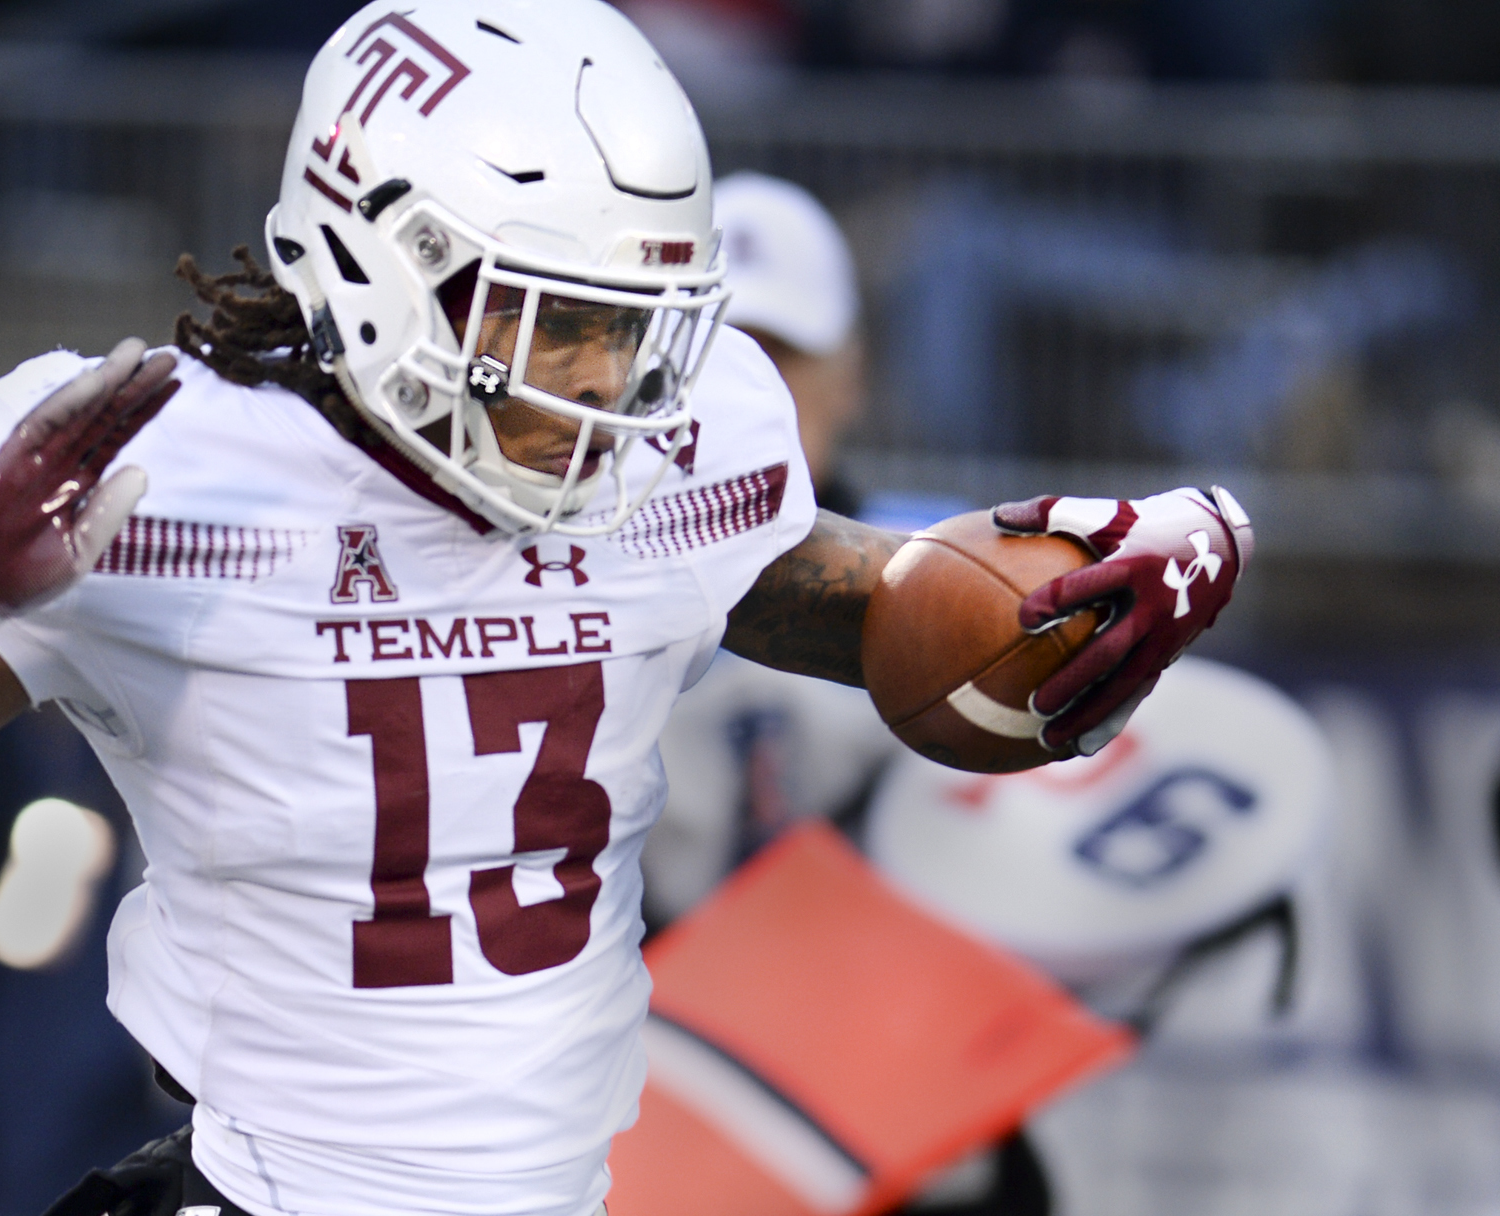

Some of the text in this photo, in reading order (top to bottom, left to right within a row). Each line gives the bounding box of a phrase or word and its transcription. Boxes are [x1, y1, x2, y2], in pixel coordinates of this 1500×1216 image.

[330, 524, 399, 604] A
[316, 611, 612, 662] TEMPLE
[344, 661, 612, 988] 13
